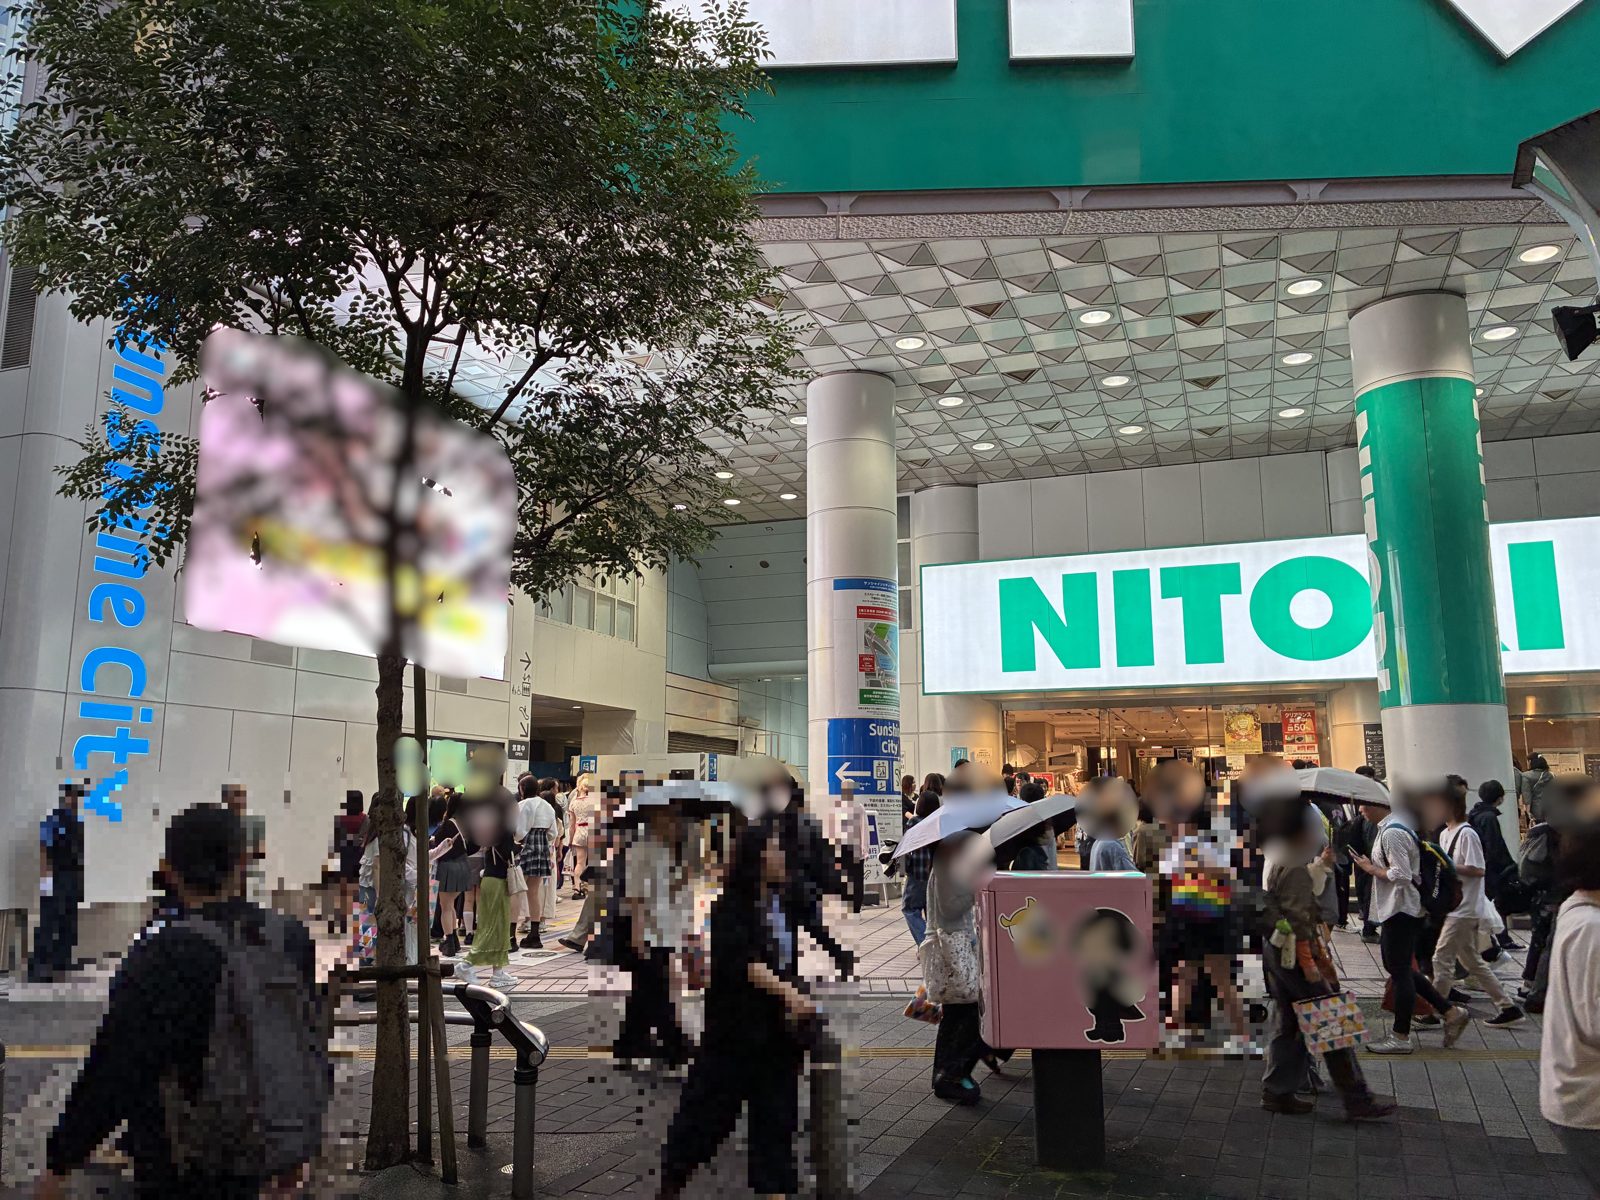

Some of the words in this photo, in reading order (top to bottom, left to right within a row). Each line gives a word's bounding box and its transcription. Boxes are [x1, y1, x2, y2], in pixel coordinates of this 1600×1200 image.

[999, 541, 1565, 673] NITOI
[869, 723, 899, 738] Sunshi
[882, 739, 898, 755] City
